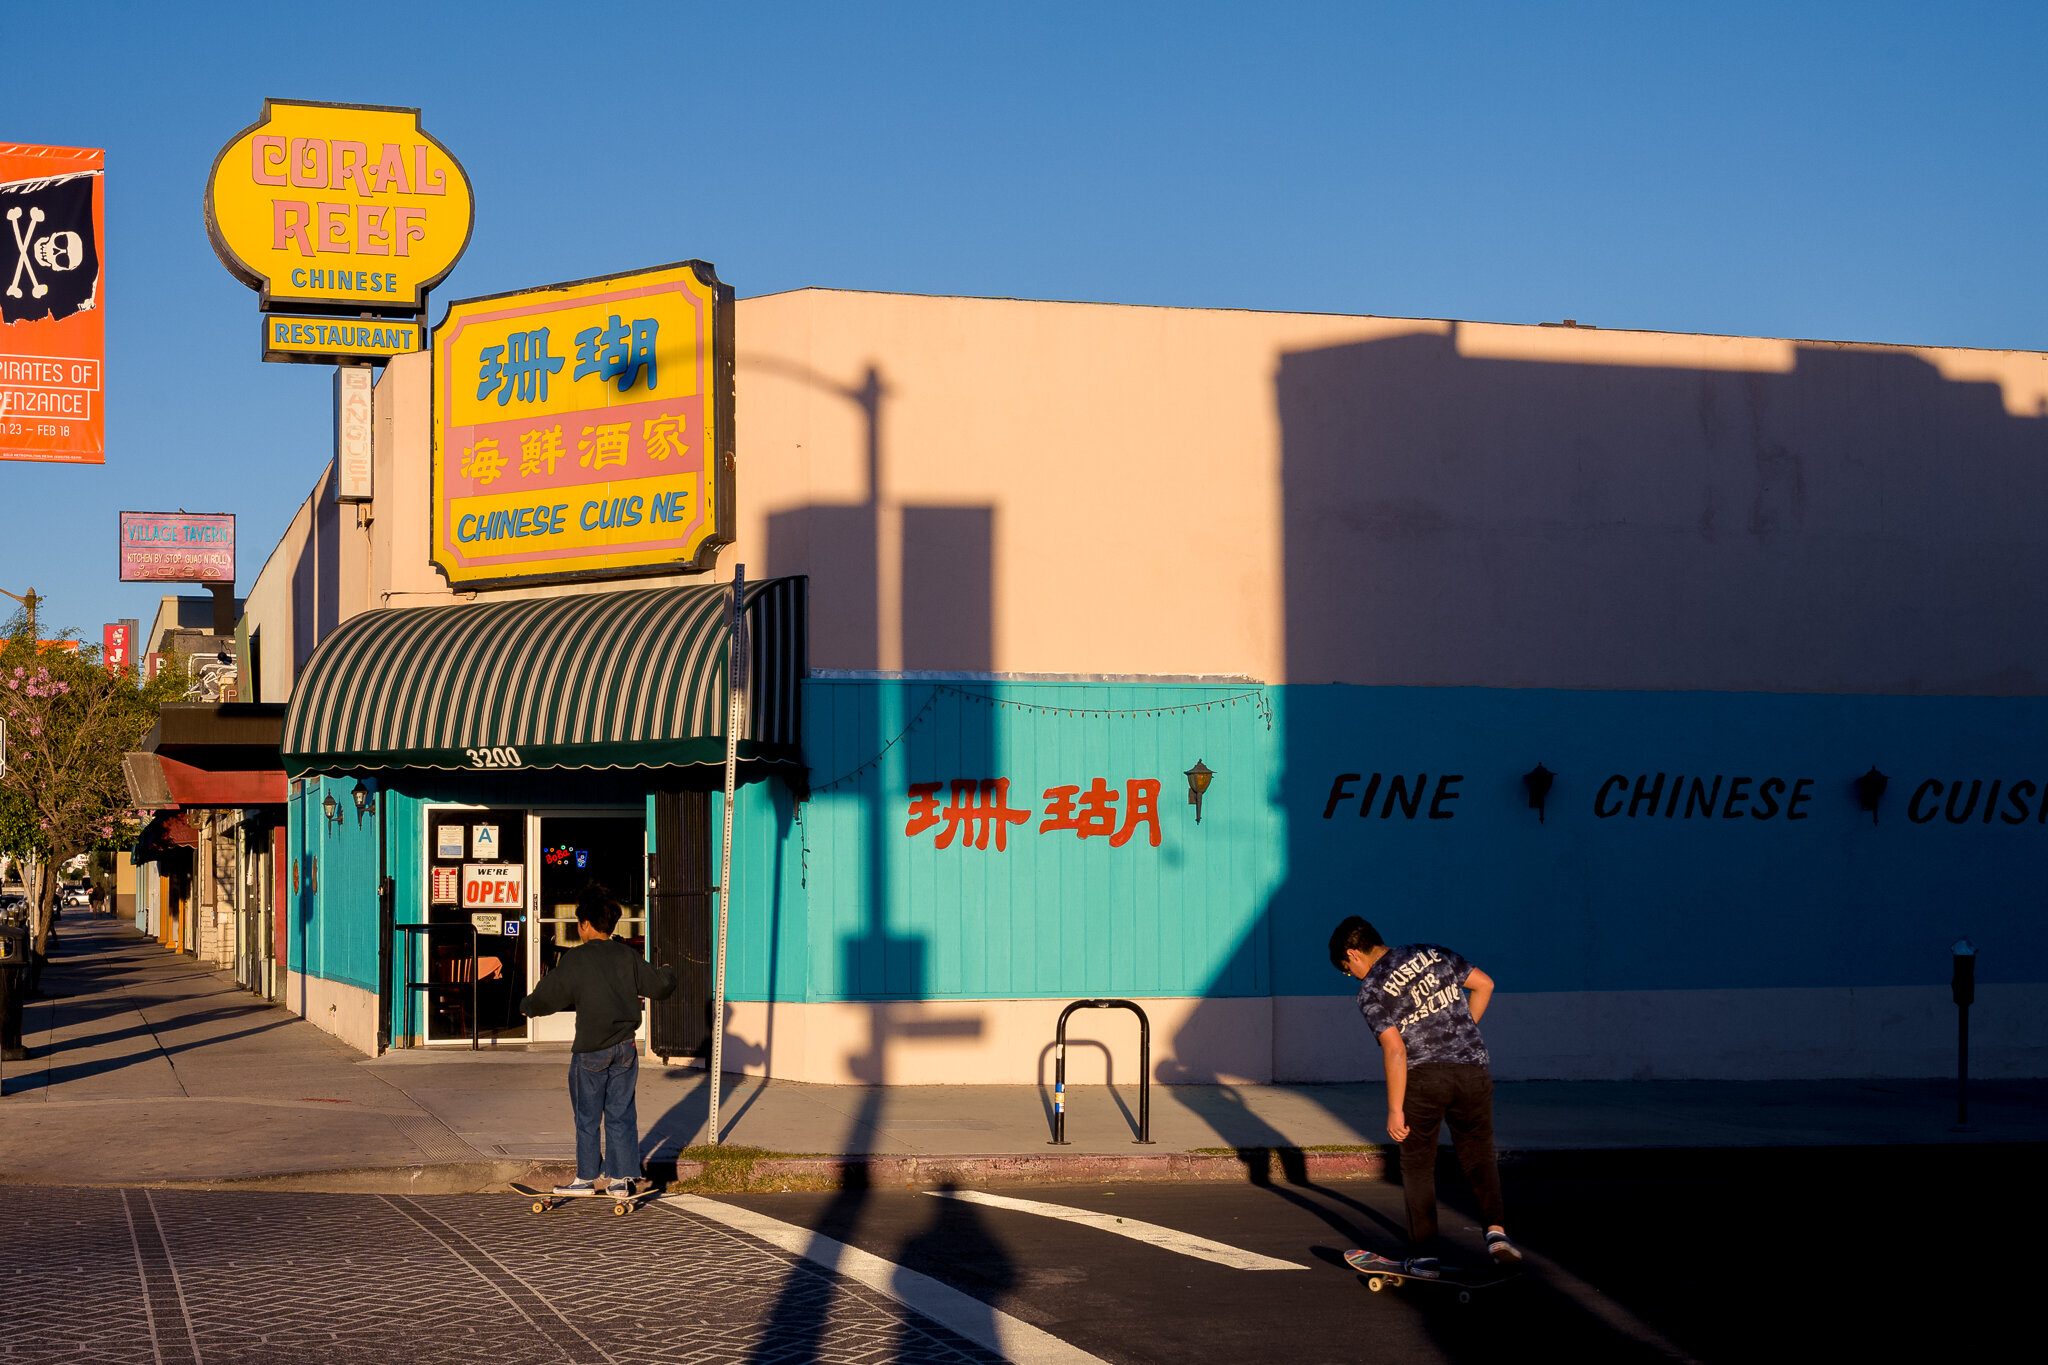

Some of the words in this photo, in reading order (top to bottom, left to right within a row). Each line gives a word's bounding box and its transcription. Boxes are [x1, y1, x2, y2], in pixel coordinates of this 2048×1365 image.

[252, 134, 446, 198] CORAL
[271, 199, 427, 257] REEF
[291, 268, 397, 292] CHINESE
[275, 323, 413, 349] RESTAURANT
[0, 361, 63, 382] IRATES
[71, 365, 93, 384] OF
[476, 314, 660, 406] 珊瑚
[0, 391, 83, 413] ENZANCE
[9, 423, 22, 435] 23
[37, 424, 56, 436] FEB
[60, 425, 70, 437] 18
[346, 373, 368, 492] BANQUET
[460, 413, 690, 485] 海鮮酒家
[127, 524, 177, 541] VILLAGE
[183, 526, 228, 542] TAVERN
[457, 504, 568, 543] CHINESE
[127, 552, 153, 563] KITCHEN
[154, 553, 163, 563] BY
[466, 746, 521, 767] 3200
[1322, 772, 1464, 819] FINE
[1594, 772, 1815, 820] CHINESE
[905, 777, 1162, 852] 珊瑚
[478, 827, 492, 843] A
[477, 868, 509, 876] WE'RE
[466, 880, 520, 903] OPEN
[1383, 948, 1442, 997] HUSTLE
[1411, 973, 1440, 1008] FOR
